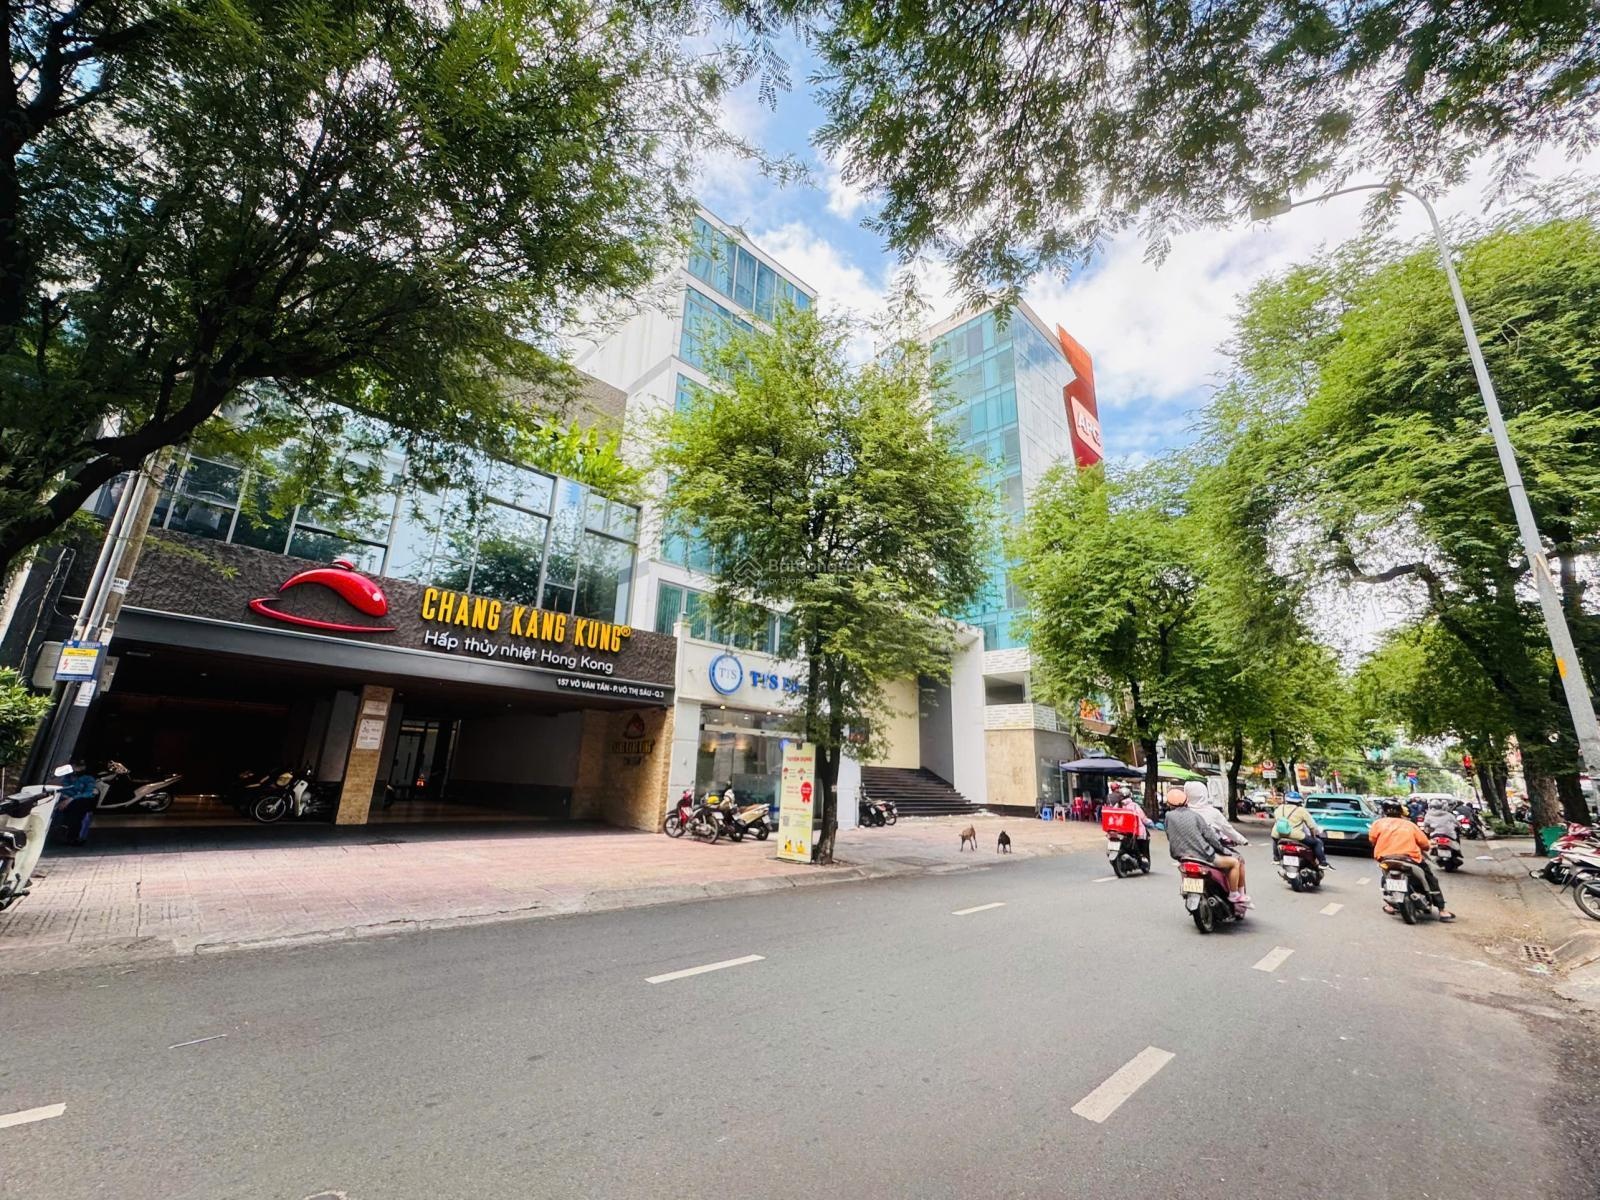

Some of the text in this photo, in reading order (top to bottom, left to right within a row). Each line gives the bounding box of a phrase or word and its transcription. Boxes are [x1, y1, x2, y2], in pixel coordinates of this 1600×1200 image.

[421, 587, 502, 631] CHANG
[510, 605, 566, 643] KANG
[424, 629, 614, 675] Hấp thủy nhiệt Hong Kong
[557, 678, 570, 687] 157
